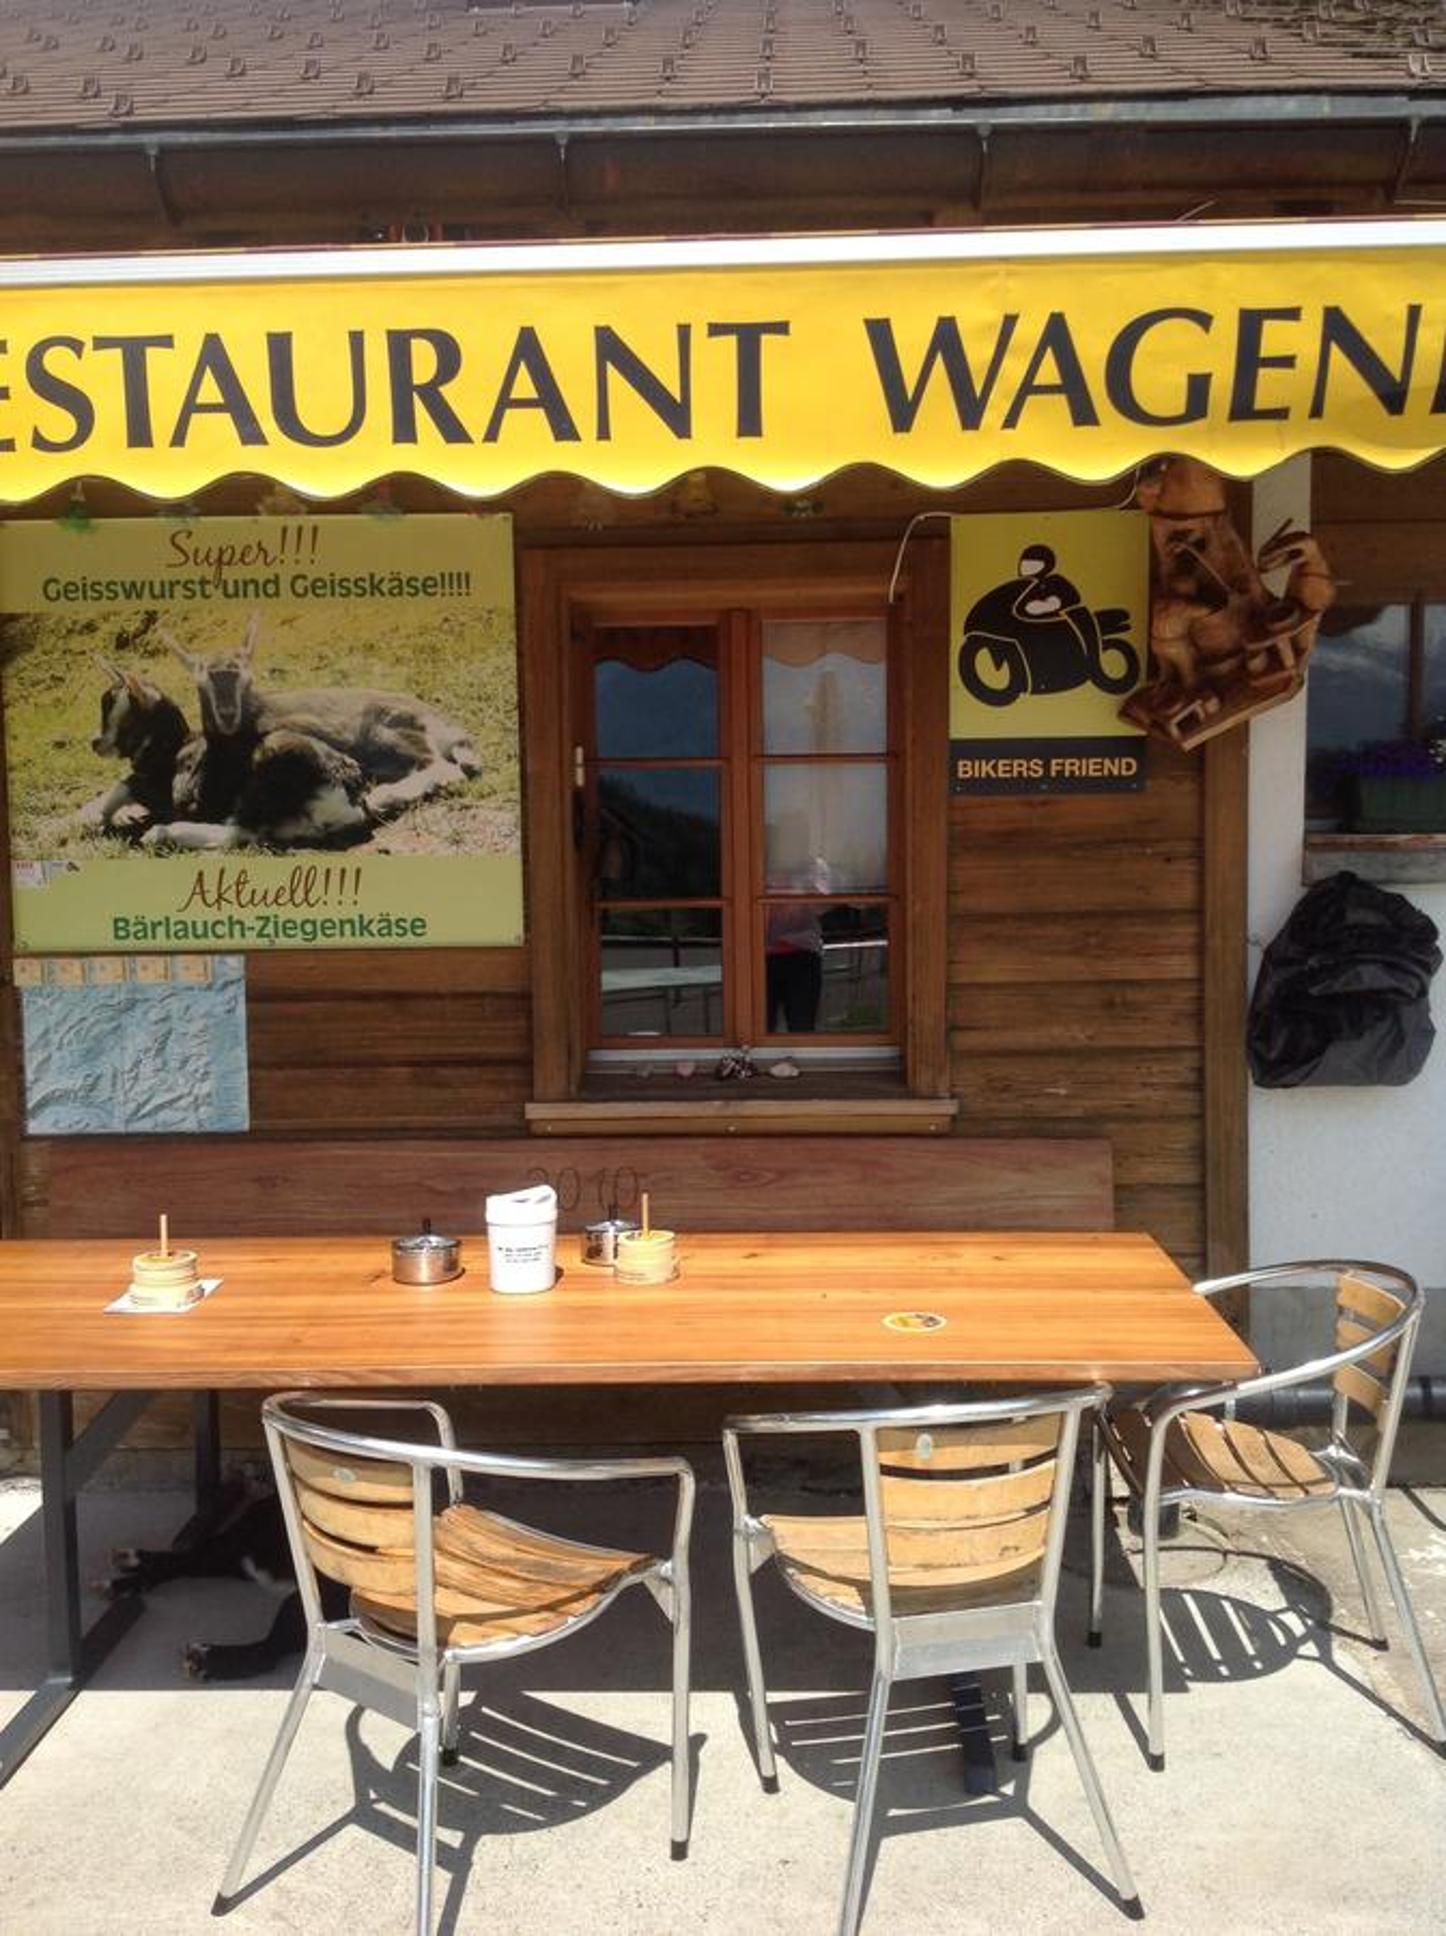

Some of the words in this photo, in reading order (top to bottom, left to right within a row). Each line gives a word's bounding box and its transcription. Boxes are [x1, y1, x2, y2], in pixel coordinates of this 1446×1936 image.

[0, 321, 790, 454] STAURANT
[863, 304, 1446, 434] WAGEN
[164, 525, 321, 587] Super!!!
[42, 575, 212, 603] Geisswurst
[217, 573, 281, 600] und
[290, 570, 473, 600] Geisskäse!!!!
[957, 758, 1044, 779] BIKERS
[1050, 757, 1138, 778] FRIEND
[176, 866, 364, 914] Aktuell!!!
[112, 911, 427, 943] Bärlauch-Ziegenkäse
